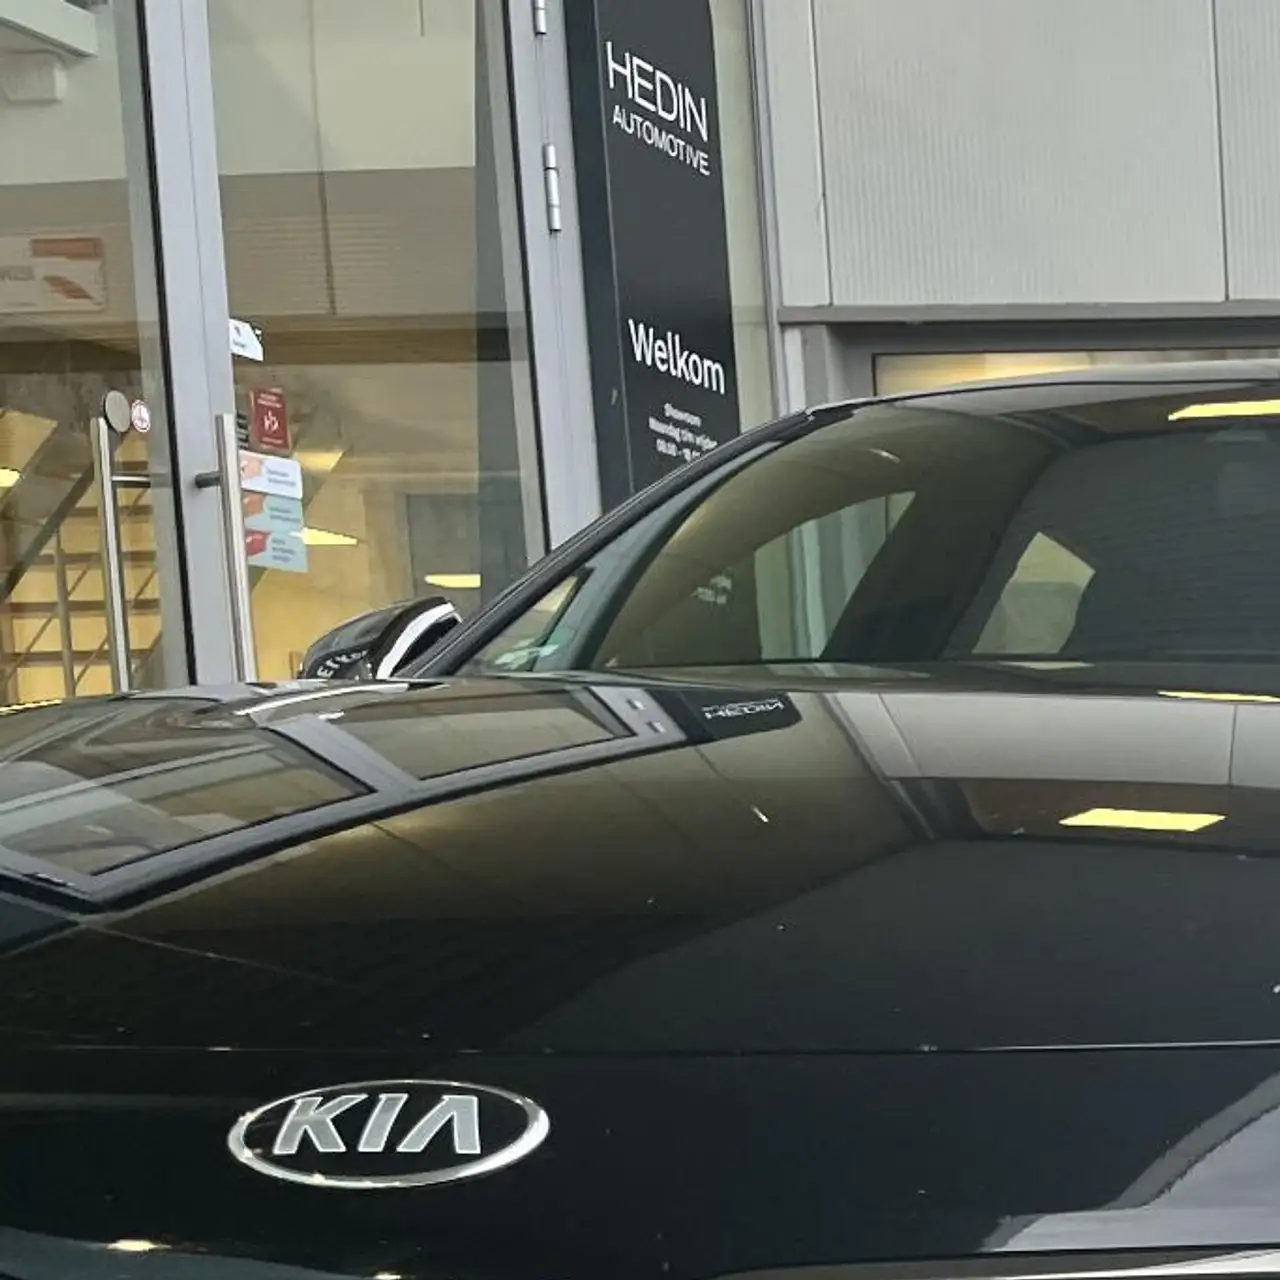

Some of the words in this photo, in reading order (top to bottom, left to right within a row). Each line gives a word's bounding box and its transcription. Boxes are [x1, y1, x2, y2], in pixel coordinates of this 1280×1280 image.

[605, 40, 709, 143] HEDIN
[612, 104, 711, 176] AUTOMOTIVE
[628, 317, 726, 395] Welkom
[272, 1093, 482, 1155] KIA
